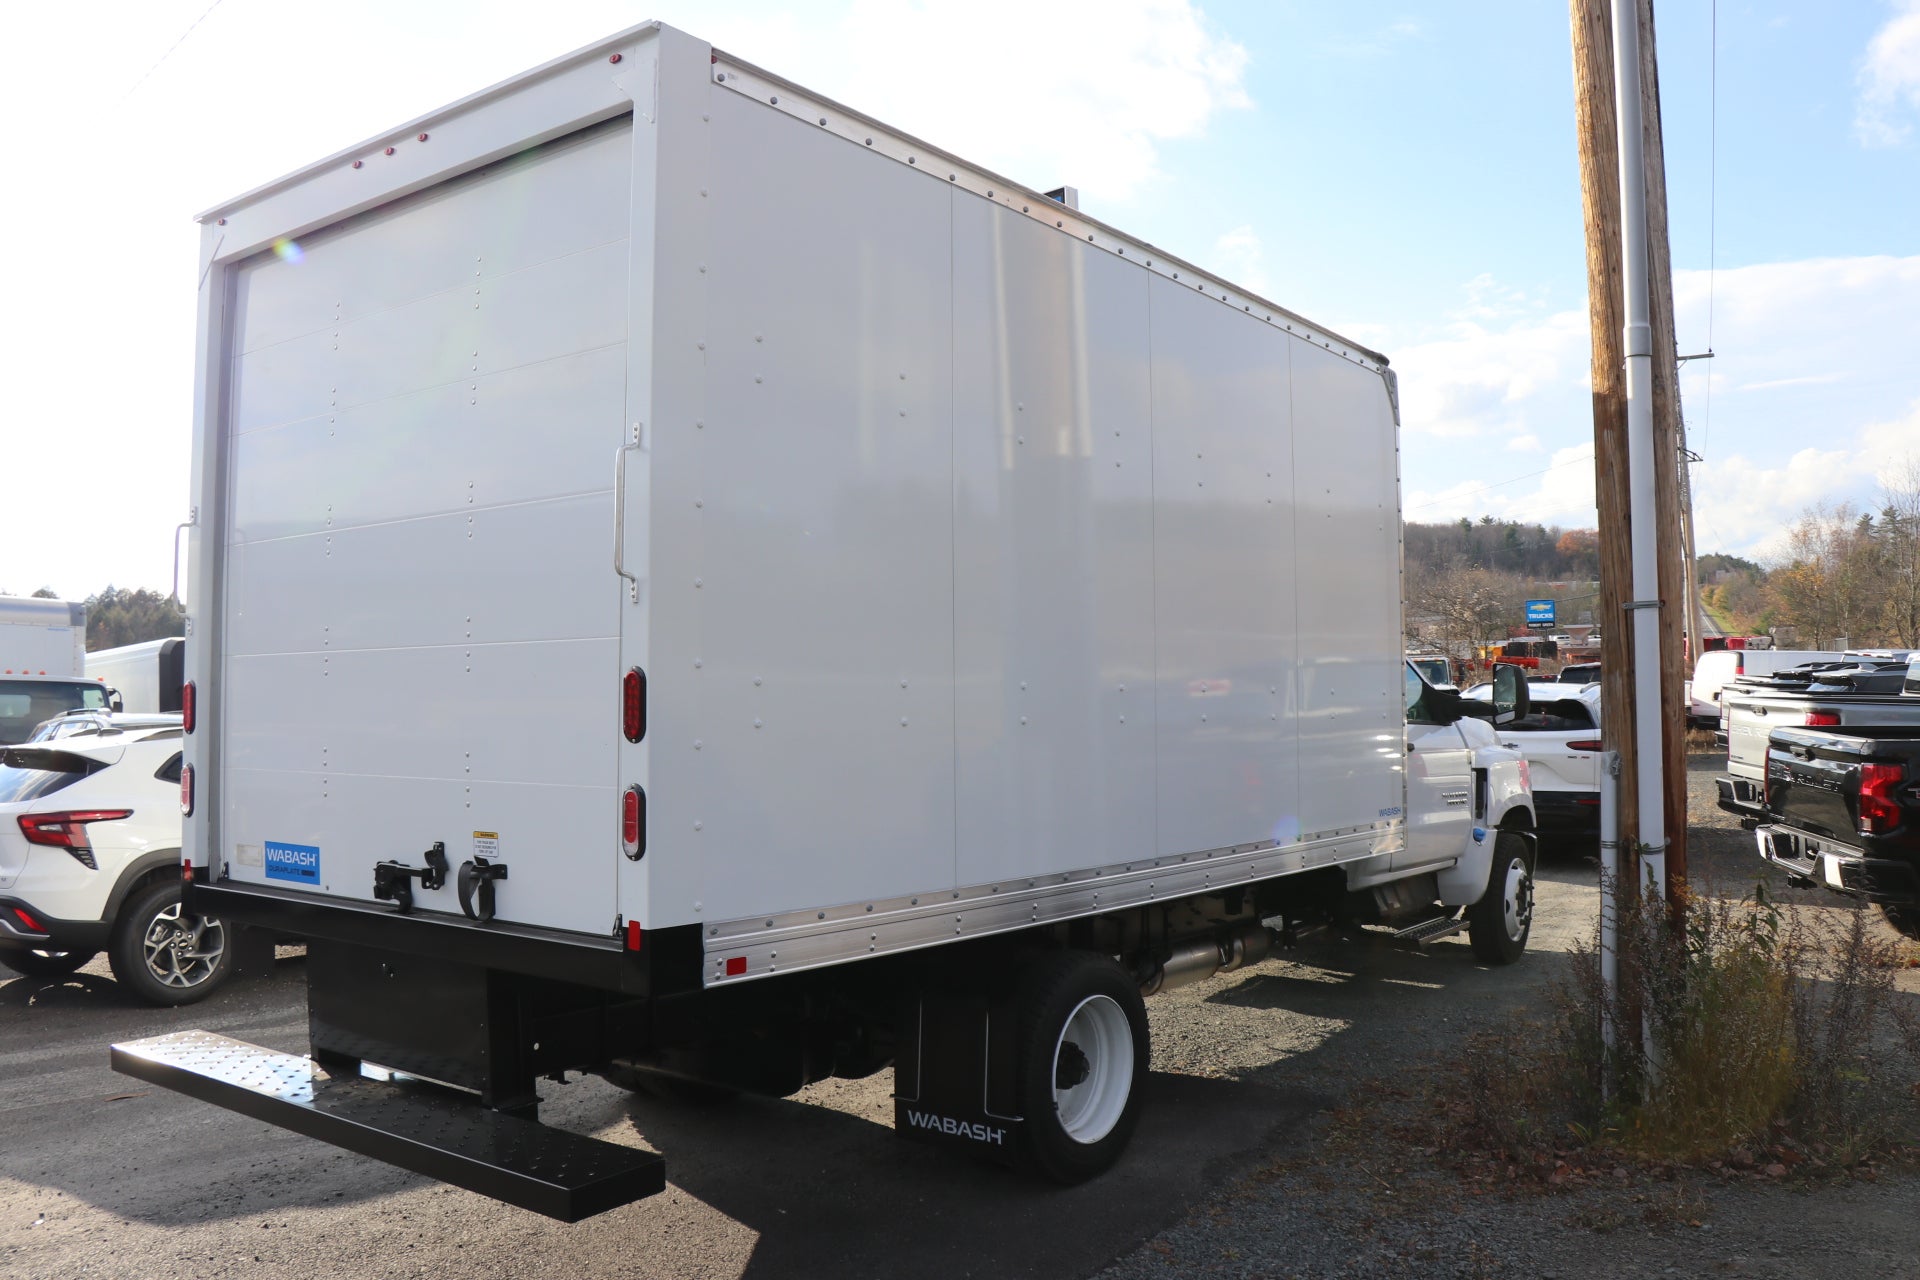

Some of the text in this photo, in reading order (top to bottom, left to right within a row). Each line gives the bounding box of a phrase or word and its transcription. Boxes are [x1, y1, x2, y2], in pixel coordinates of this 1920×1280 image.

[1379, 807, 1401, 817] WABASH
[267, 848, 316, 866] WABASH
[908, 1109, 1004, 1145] WABASH
